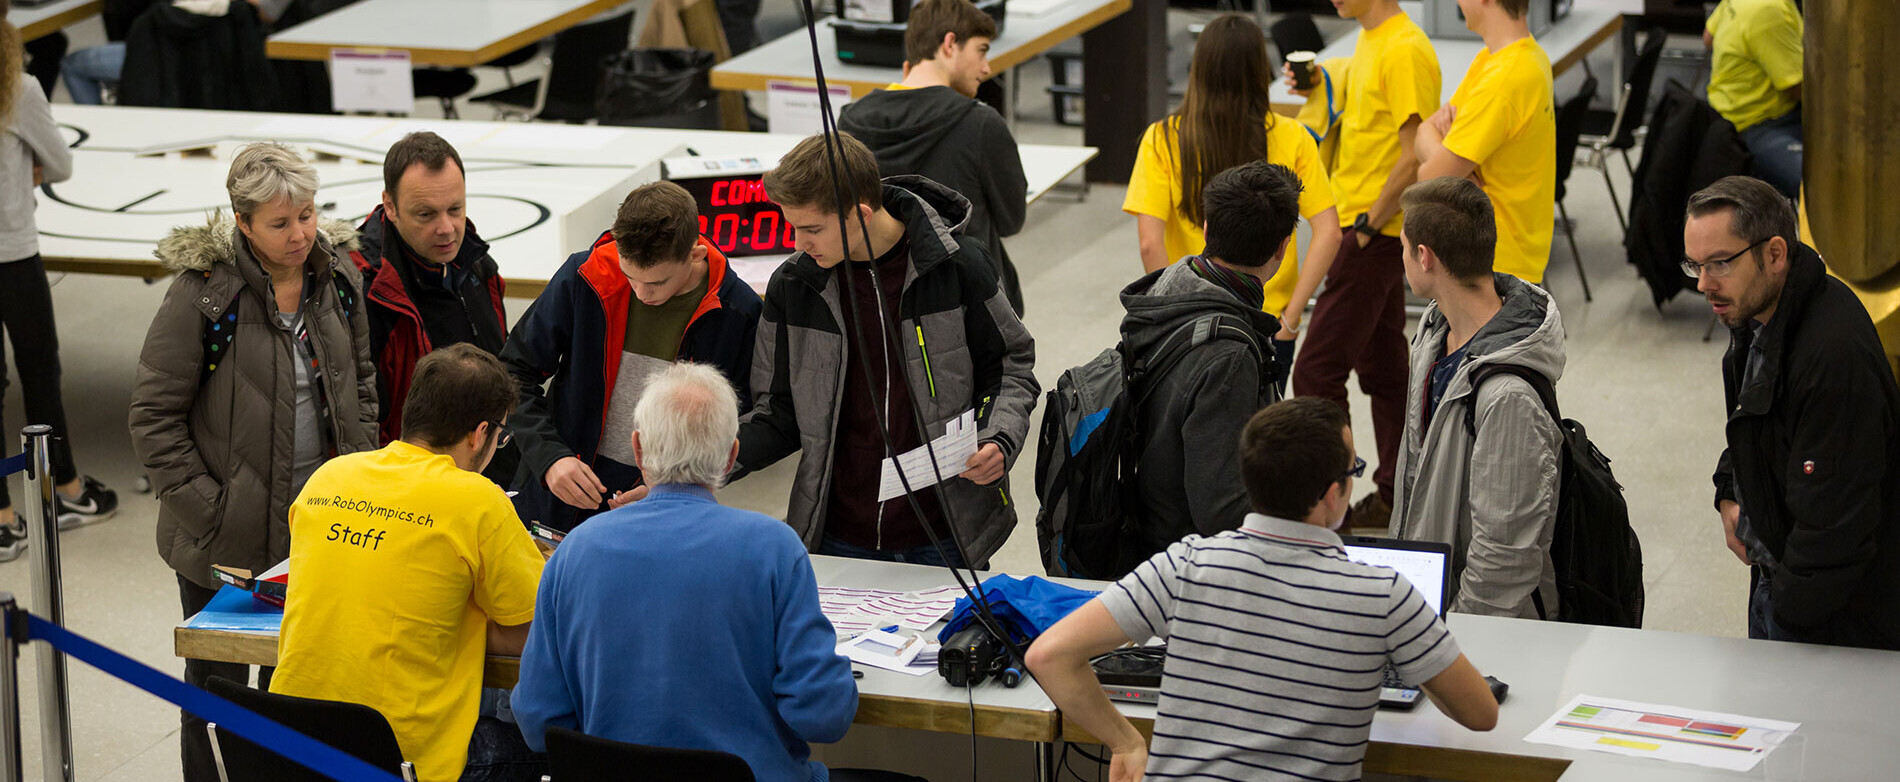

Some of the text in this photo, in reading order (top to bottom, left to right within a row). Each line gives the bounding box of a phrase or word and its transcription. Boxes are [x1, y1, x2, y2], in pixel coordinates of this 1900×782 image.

[711, 180, 769, 207] COM
[306, 495, 434, 528] www.RobOlympics.ch
[326, 523, 386, 551] Staff
